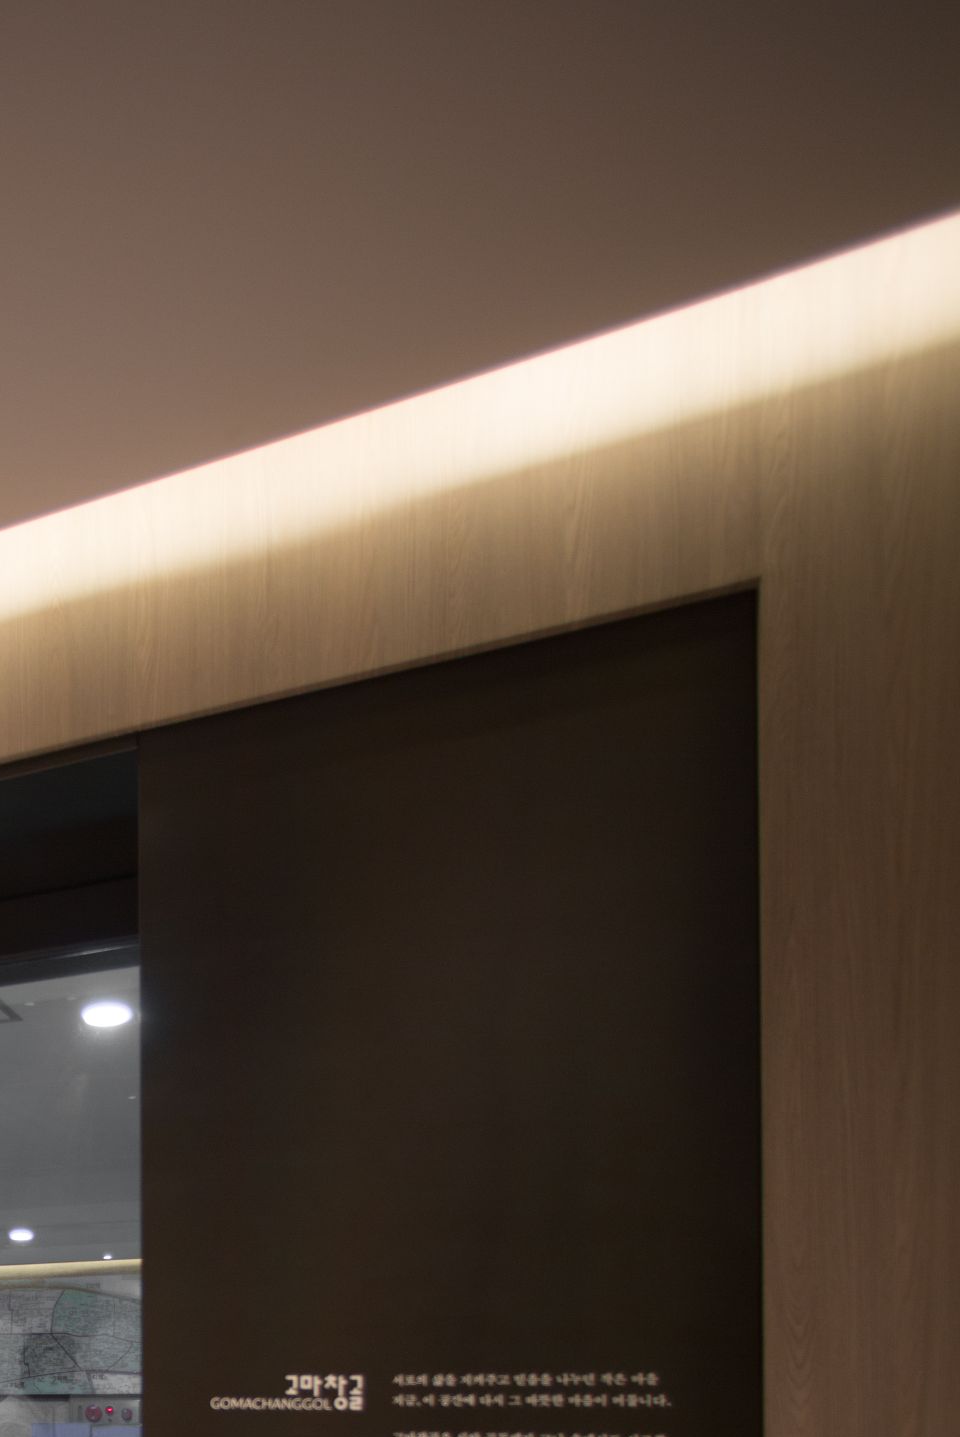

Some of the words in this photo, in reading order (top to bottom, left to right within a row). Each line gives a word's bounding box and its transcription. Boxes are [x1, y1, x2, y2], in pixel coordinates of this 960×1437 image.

[285, 1374, 364, 1411] 고마창골
[508, 1395, 522, 1405] 그
[210, 1396, 332, 1411] GOMACHANGGOL
